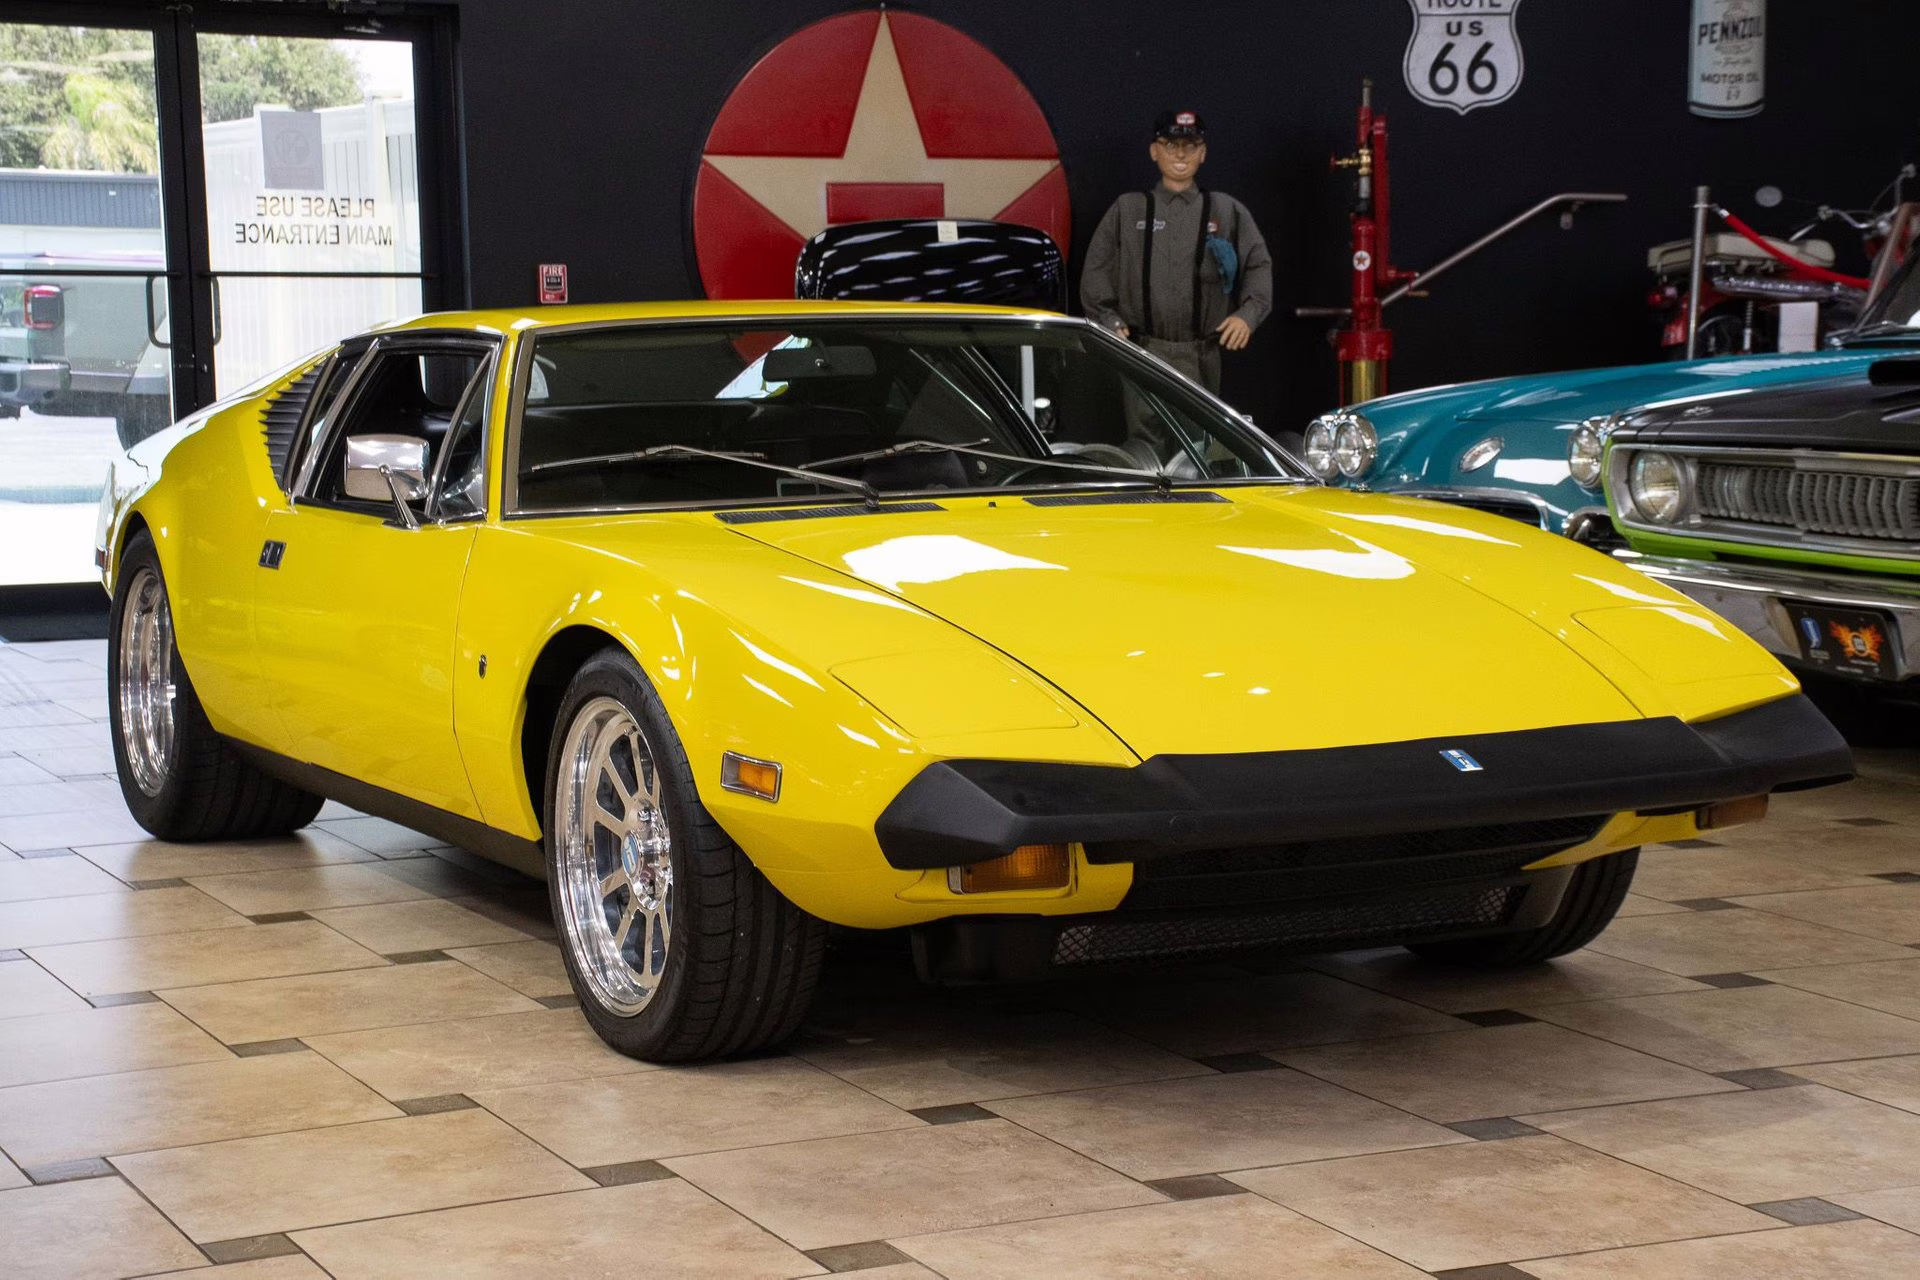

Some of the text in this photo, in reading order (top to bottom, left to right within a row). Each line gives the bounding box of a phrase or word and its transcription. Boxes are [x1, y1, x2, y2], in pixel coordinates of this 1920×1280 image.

[1446, 21, 1483, 36] US
[1428, 41, 1498, 95] 66
[543, 265, 563, 276] FIRE
